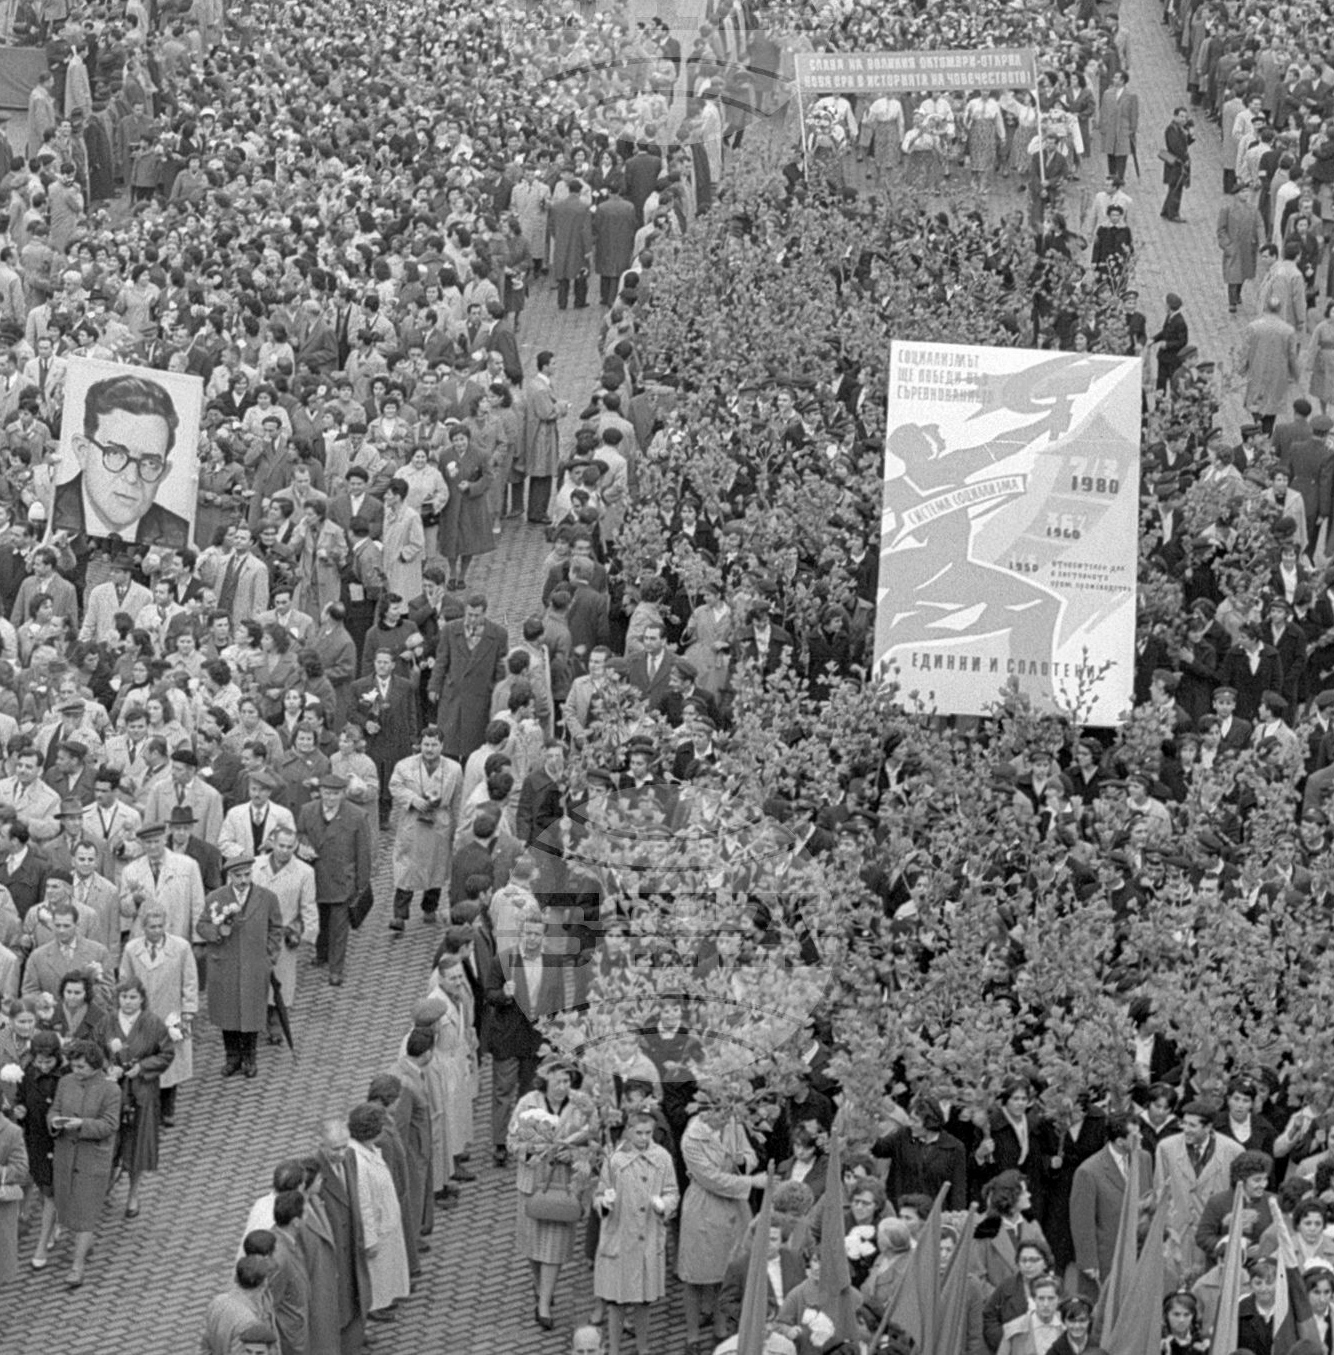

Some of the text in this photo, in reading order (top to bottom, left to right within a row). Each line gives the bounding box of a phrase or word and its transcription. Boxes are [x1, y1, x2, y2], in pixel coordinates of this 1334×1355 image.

[809, 58, 844, 71] СЛАВА
[848, 58, 863, 71] НА
[931, 73, 945, 86] НА
[898, 349, 979, 368] СОЦИАЛИЗМЪТ
[919, 369, 961, 385] ПОБЕДИ
[1071, 475, 1119, 494] 1980
[1046, 527, 1081, 540] 1960
[1008, 561, 1039, 573] 1950
[911, 651, 979, 673] ЕДИННИ
[986, 657, 995, 673] И
